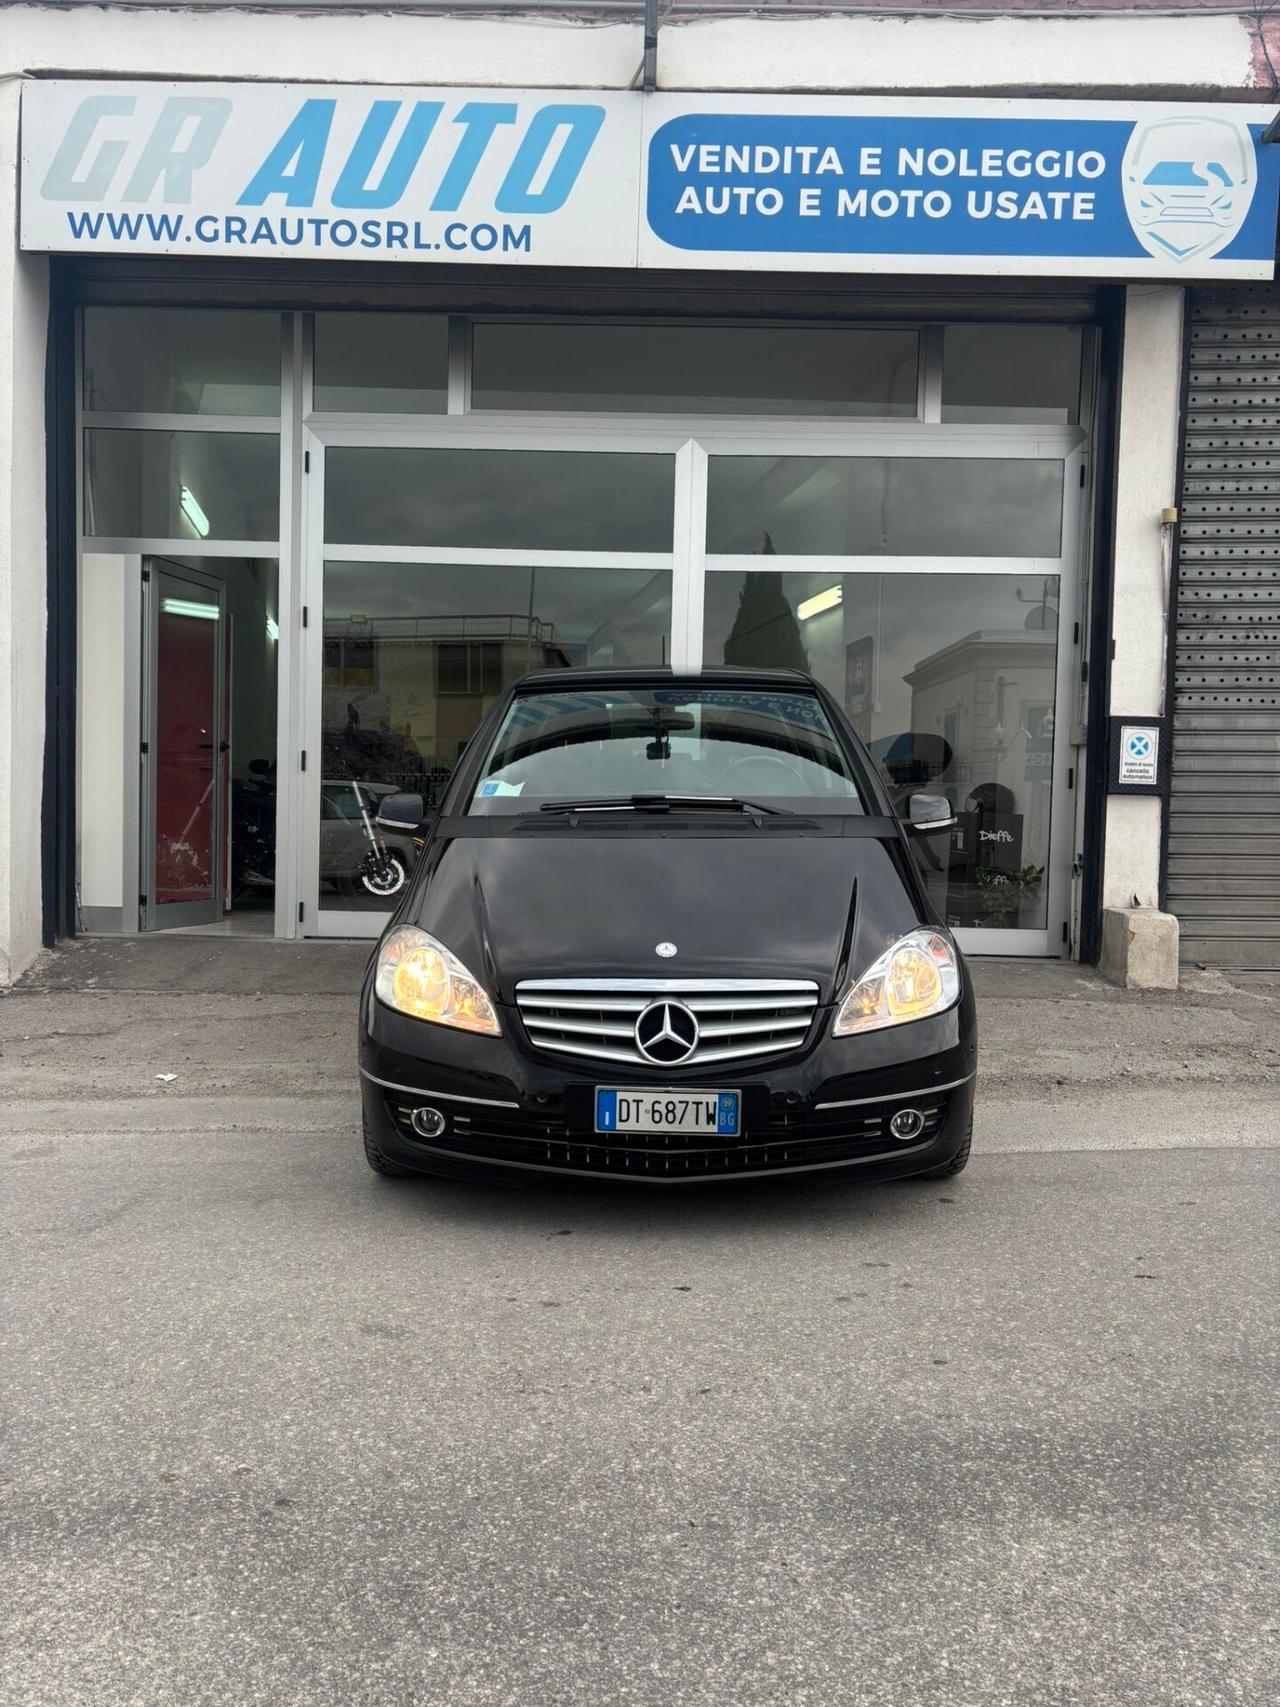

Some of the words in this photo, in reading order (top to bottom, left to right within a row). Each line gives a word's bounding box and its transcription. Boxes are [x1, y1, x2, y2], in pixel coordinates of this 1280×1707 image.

[40, 95, 233, 204] GR
[236, 98, 606, 214] AUTO
[670, 144, 843, 175] VENDITA
[860, 147, 882, 176] E
[898, 147, 1106, 179] NOLEGGIO
[675, 186, 783, 216] AUTO
[799, 188, 821, 216] E
[837, 189, 952, 219] MOTO
[967, 190, 1095, 221] USATE
[67, 211, 532, 252] WWW.GRAUTOSRL.COM
[978, 830, 1014, 842] Dieffe
[719, 1112, 735, 1126] BG
